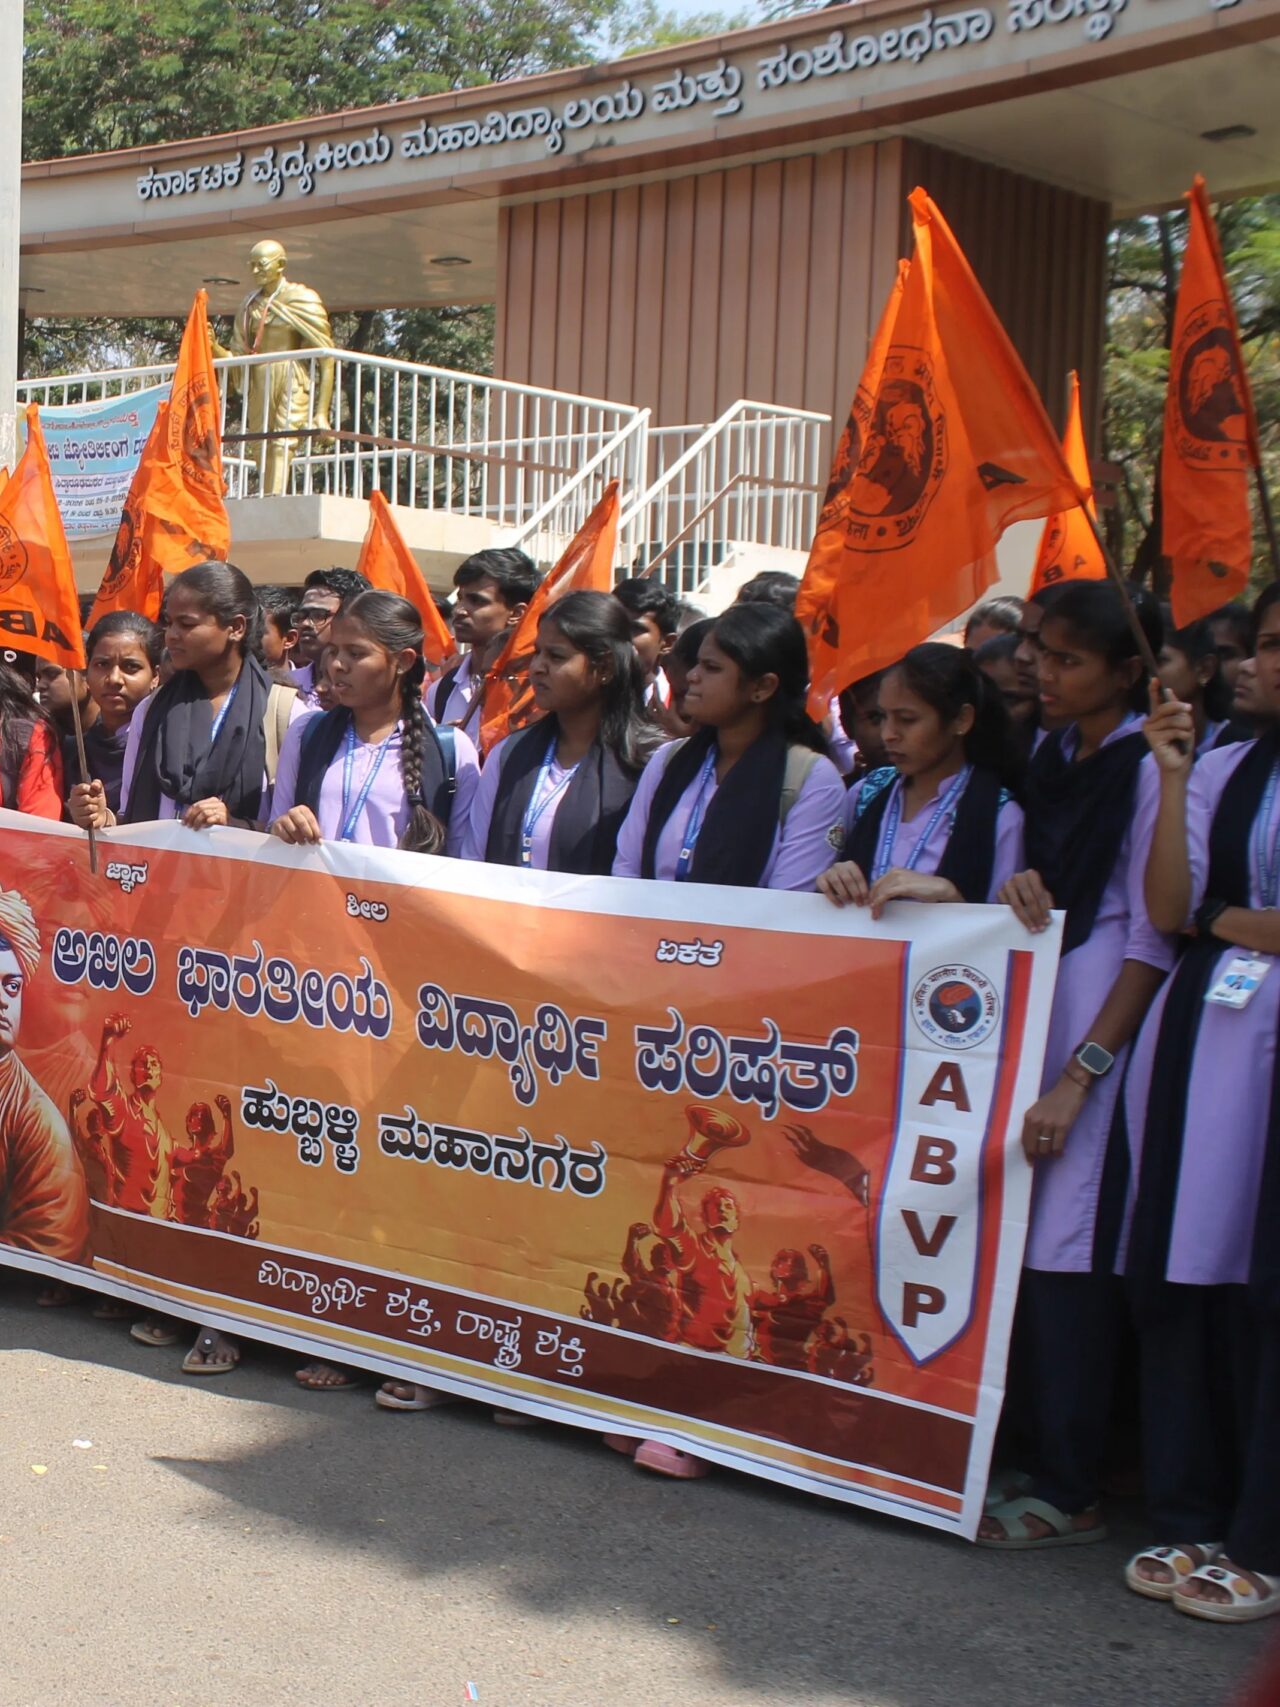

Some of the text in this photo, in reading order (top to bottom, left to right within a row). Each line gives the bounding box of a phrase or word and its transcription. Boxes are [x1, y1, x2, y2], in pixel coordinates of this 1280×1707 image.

[136, 152, 243, 200] ಕರ್ನಾಟಕ
[250, 129, 392, 196] ವೈದ್ಯಕೀಯ
[400, 80, 644, 154] ಮಹಾವಿದ್ಯಾಲಯ
[652, 59, 743, 116] ಮತ್ತು
[756, 5, 994, 91] ಸಂಶೋಧನಾ
[106, 861, 148, 893] ಜ್ಞಾನ
[345, 893, 389, 922] ಶೀಲ
[656, 936, 725, 967] ಏಕತೆ
[51, 926, 860, 1121] ಅಖಿಲ ಭಾರತೀಯ ವಿದ್ಯಾರ್ಥಿ ಪರಿಷತ್
[240, 1078, 608, 1198] ಹುಬ್ಬಳ್ಳಿ ಮಹಾನಗರ
[899, 1060, 972, 1329] ABVP
[257, 1260, 586, 1378] ವಿದ್ಯಾರ್ಥಿ ಶಕ್ತಿ, ರಾಷ್ಟ್ರ ಶಕ್ತಿ
